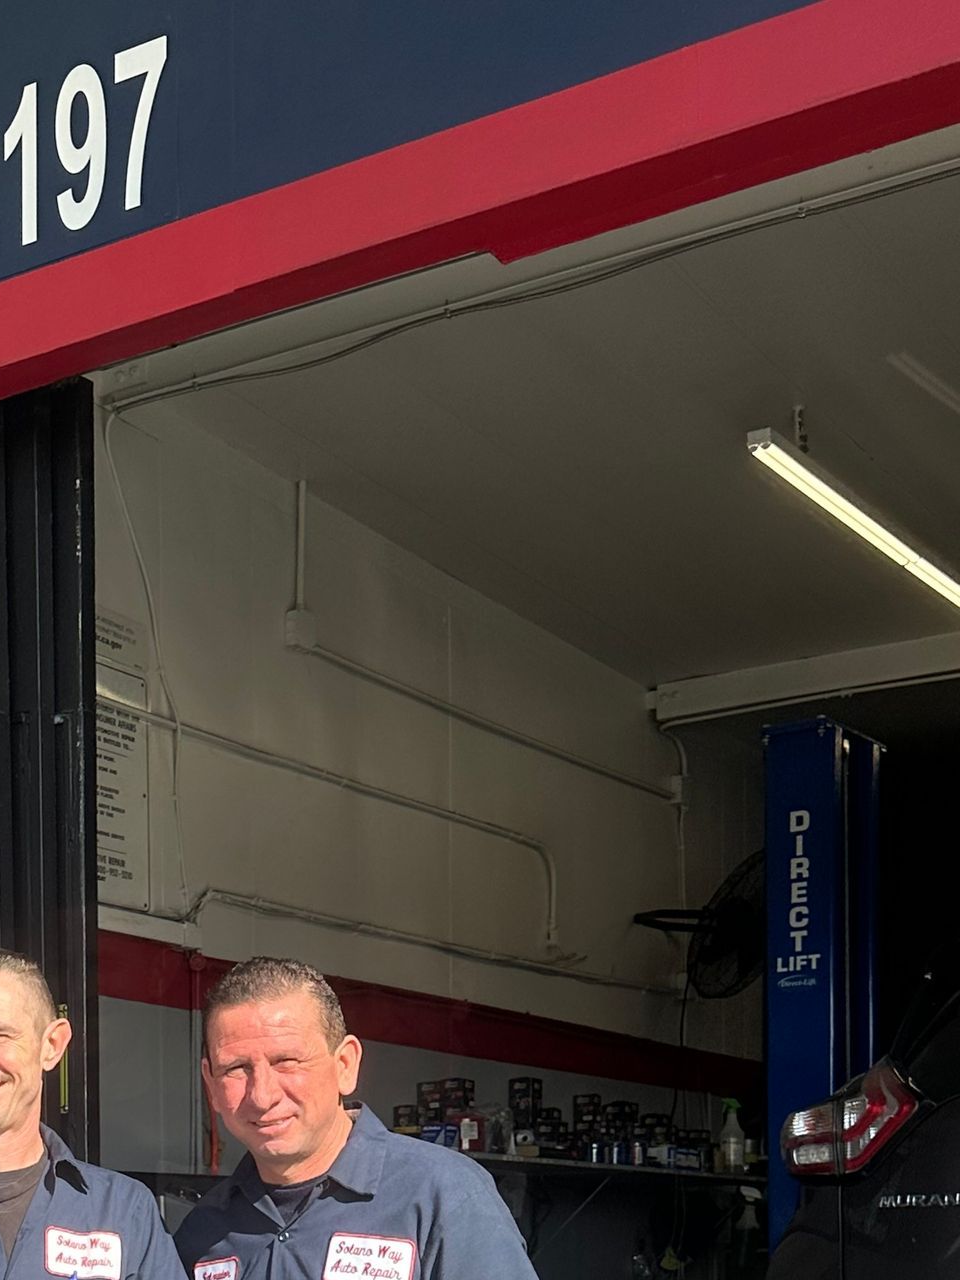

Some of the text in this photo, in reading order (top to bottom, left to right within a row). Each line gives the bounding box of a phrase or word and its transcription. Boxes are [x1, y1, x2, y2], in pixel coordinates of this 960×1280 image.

[789, 810, 810, 952] DIRECT
[776, 954, 821, 972] LIFT
[56, 1235, 111, 1252] Solano Way
[336, 1241, 403, 1263] Solano Way
[55, 1252, 114, 1270] Auto Repair
[330, 1259, 402, 1280] Auto Repair
